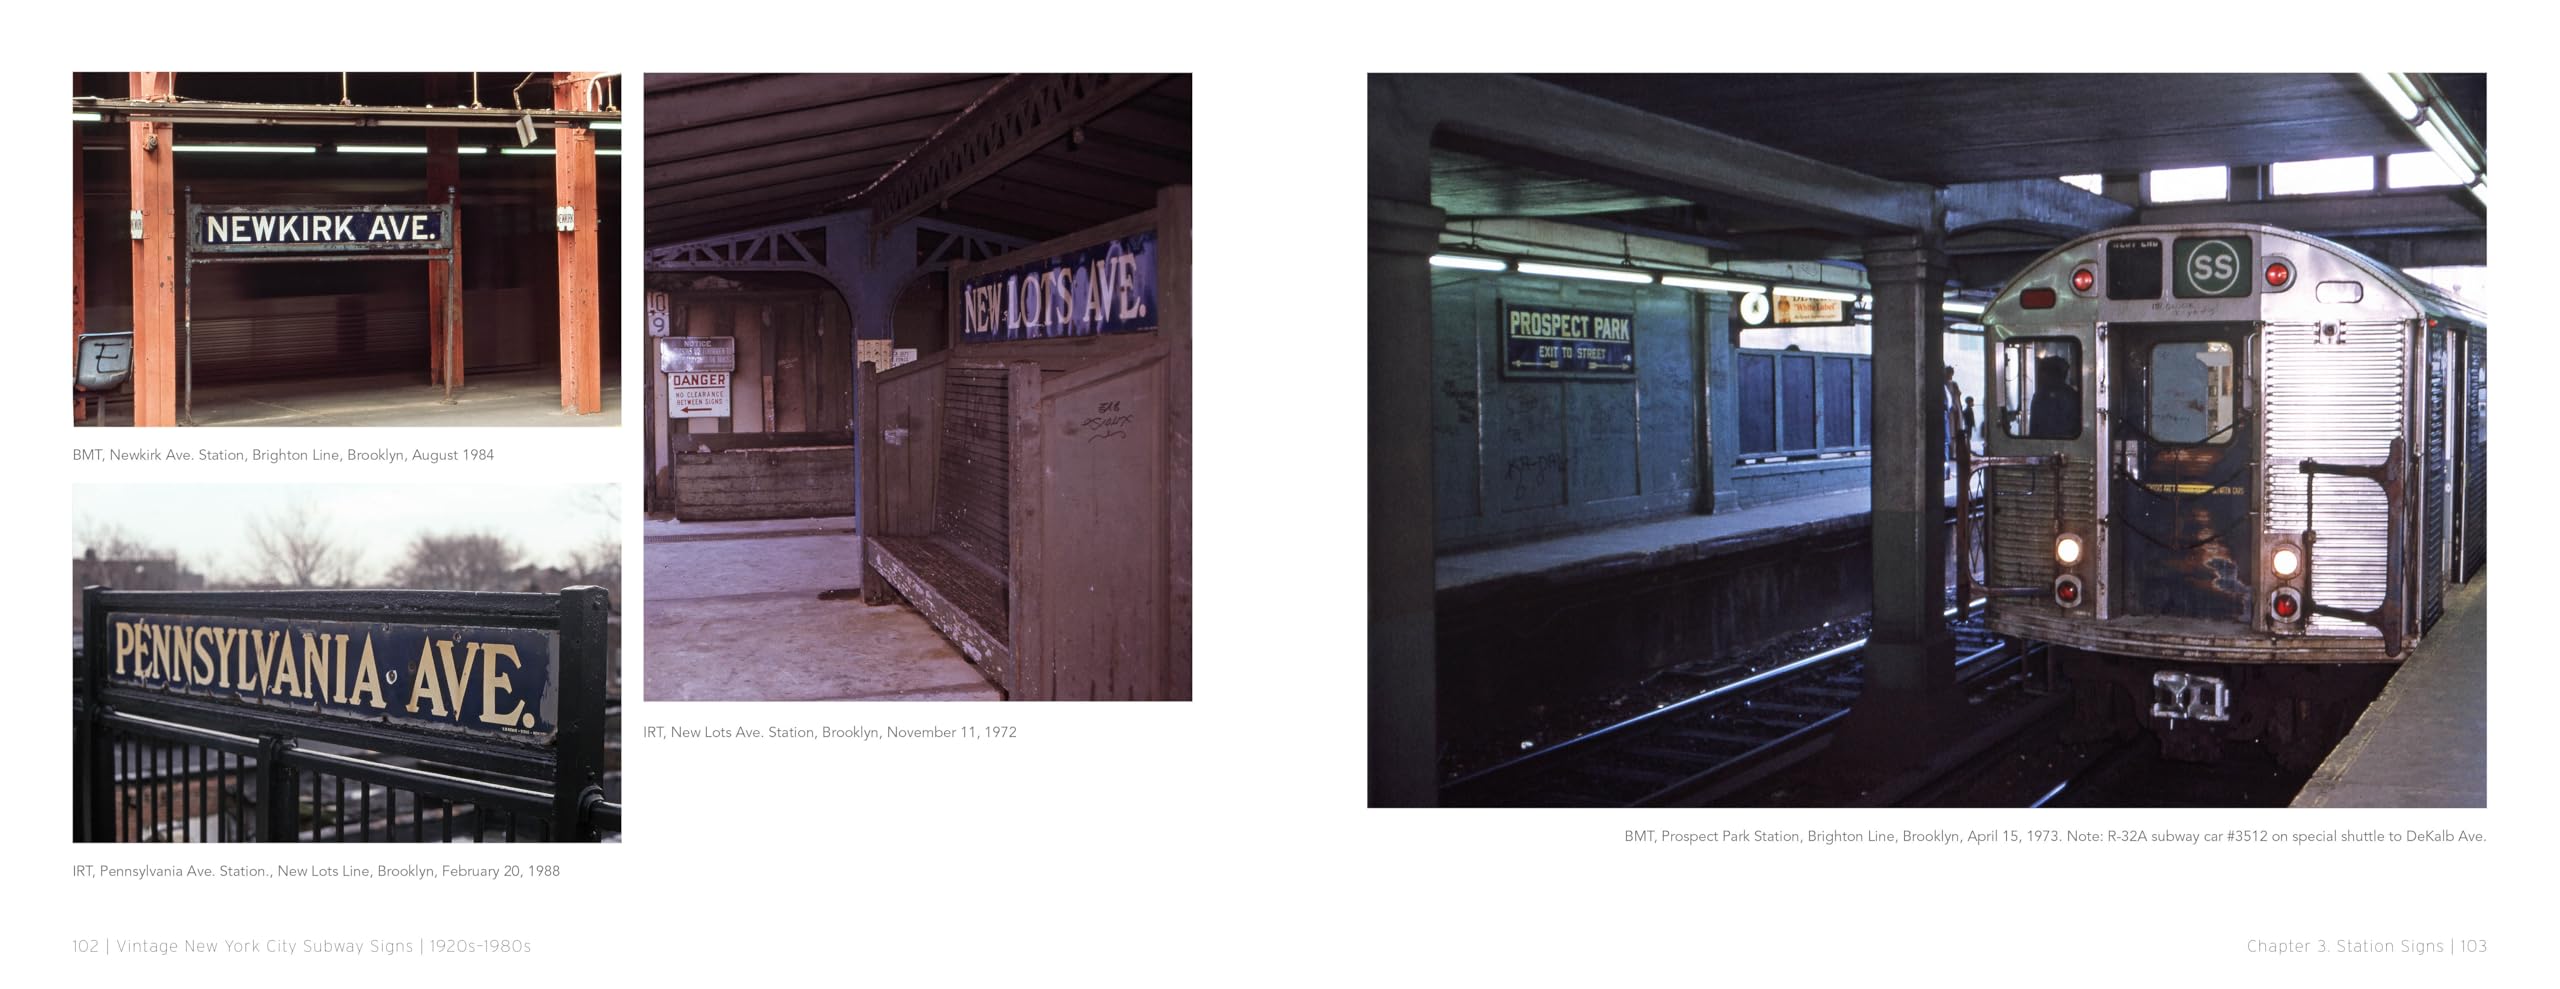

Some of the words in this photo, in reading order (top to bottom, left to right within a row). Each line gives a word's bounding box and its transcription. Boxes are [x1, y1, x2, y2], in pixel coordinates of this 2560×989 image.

[208, 215, 356, 242] NEWKIRK
[368, 215, 435, 241] AVE.
[2194, 255, 2233, 280] SS
[965, 282, 1002, 334] NEW
[1007, 267, 1073, 329] LOTS
[1082, 253, 1146, 322] AVE.
[653, 317, 665, 333] 9
[1510, 311, 1589, 338] PROSPECT
[1594, 317, 1630, 340] PARK
[1539, 346, 1558, 358] EXIT
[1561, 347, 1572, 358] TO
[1577, 347, 1606, 359] STREET
[673, 374, 726, 386] DANGER
[115, 621, 387, 709] PENNSYLVANIA
[405, 635, 536, 729] AVE.
